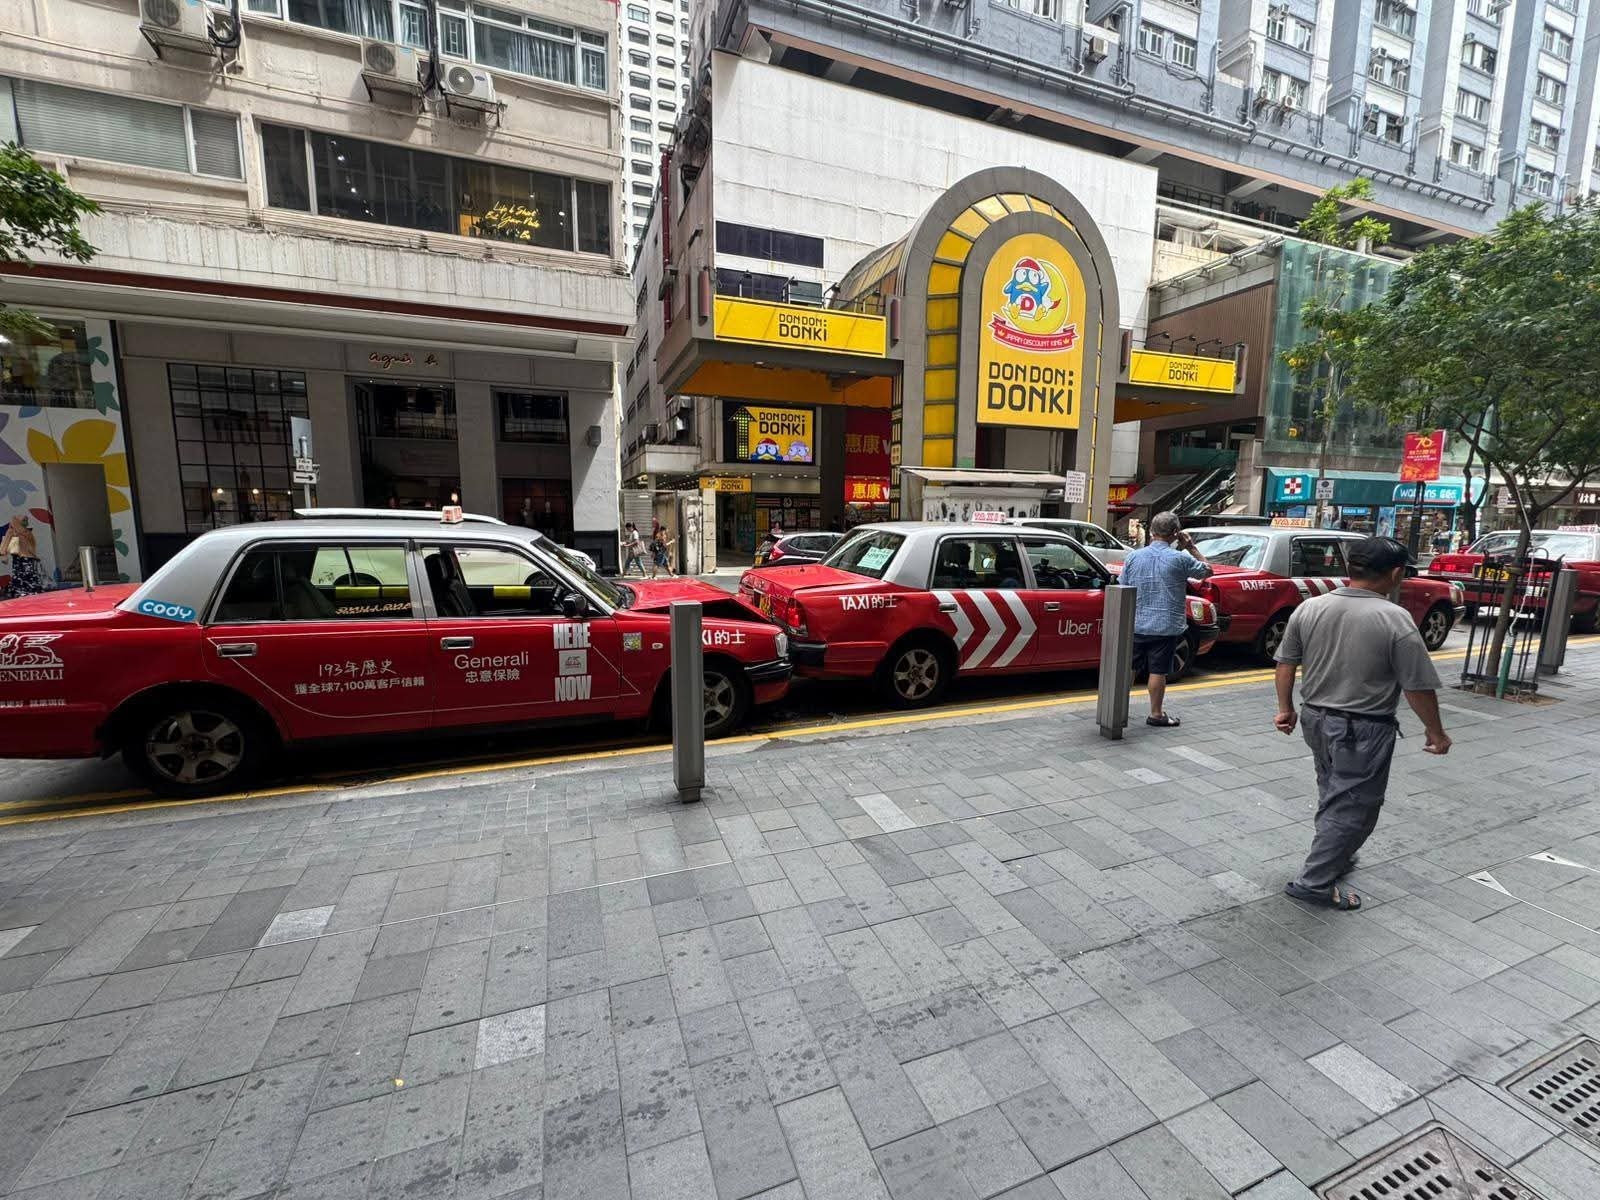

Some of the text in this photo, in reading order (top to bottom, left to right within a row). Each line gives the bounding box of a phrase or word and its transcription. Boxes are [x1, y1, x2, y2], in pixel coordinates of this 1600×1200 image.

[779, 323, 827, 341] DONKI
[1023, 338, 1049, 347] DISCOUNT
[1050, 338, 1063, 346] KING
[1169, 368, 1198, 382] DONKI
[987, 382, 1073, 415] DONKI
[759, 421, 805, 436] DONKI
[852, 482, 881, 499] 惠康
[1239, 580, 1258, 590] TAXI
[142, 601, 193, 619] cody
[839, 595, 870, 611] TAXI
[1058, 619, 1092, 636] Uber
[552, 623, 591, 650] HERE
[454, 651, 529, 669] Generali
[0, 669, 64, 682] ENERALI
[465, 669, 520, 684] 忠意保險
[554, 674, 592, 702] NOW
